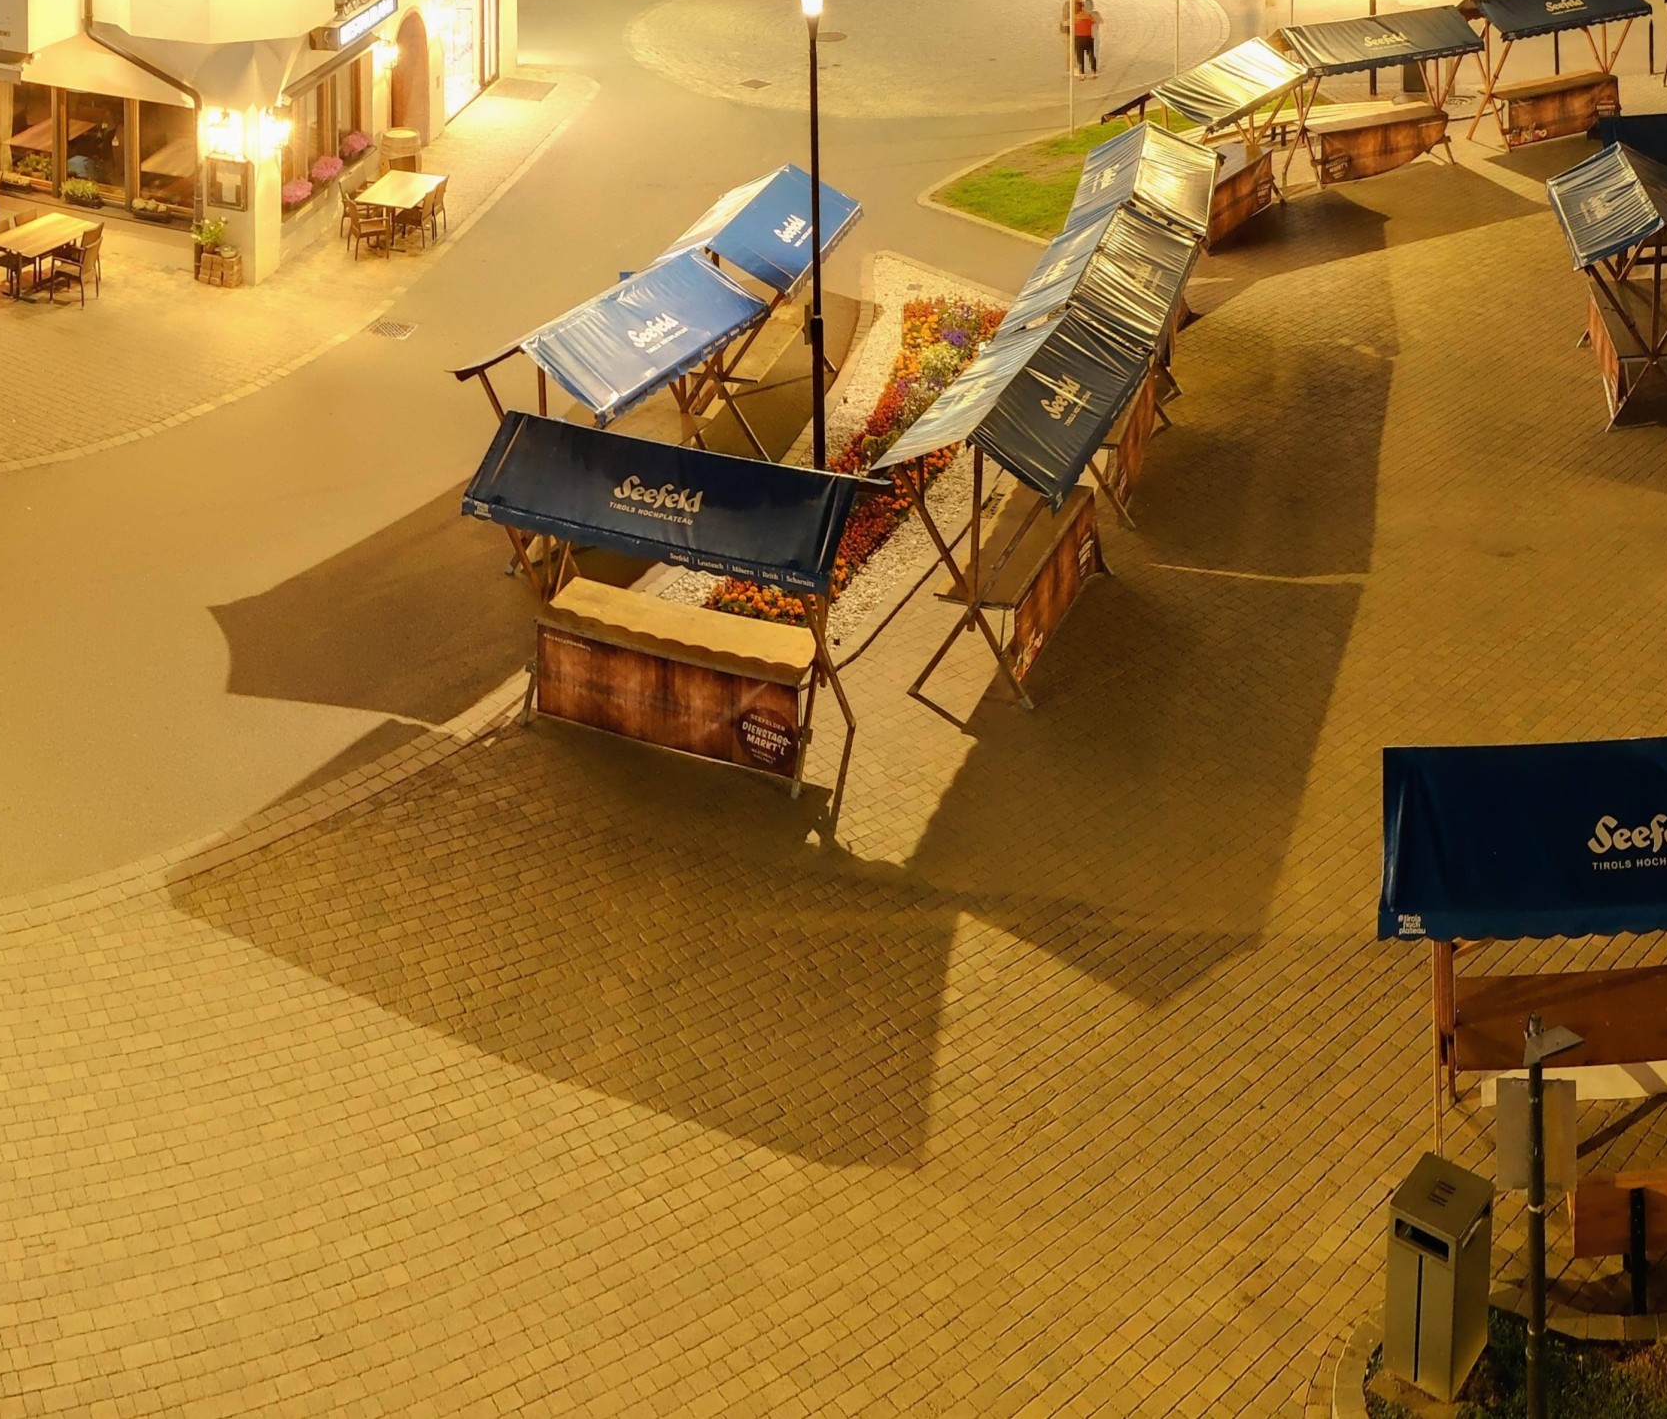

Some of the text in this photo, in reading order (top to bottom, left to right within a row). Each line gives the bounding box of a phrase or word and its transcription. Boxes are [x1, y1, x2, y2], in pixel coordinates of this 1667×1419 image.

[627, 312, 679, 348] Seefeld
[614, 475, 704, 514] Seefeld
[609, 501, 694, 527] TIROLS HOCHPLATEAU
[742, 721, 792, 746] DIENSTAGS-
[750, 713, 786, 731] SEEFELDER
[746, 734, 786, 756] MARKT'L
[1592, 859, 1632, 872] TIROLS
